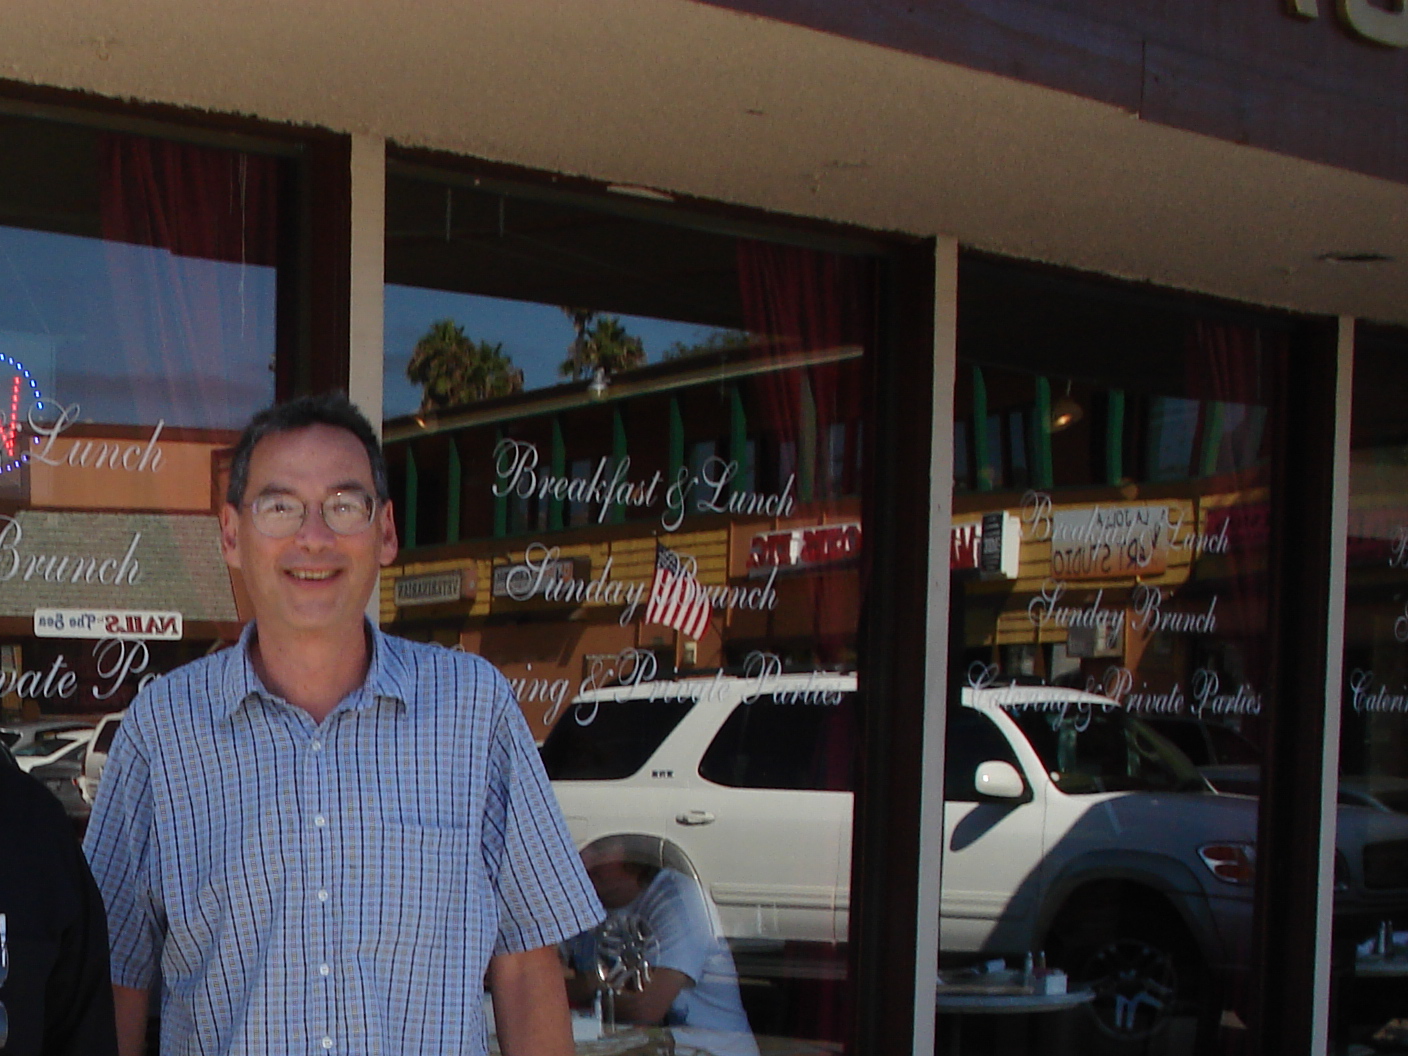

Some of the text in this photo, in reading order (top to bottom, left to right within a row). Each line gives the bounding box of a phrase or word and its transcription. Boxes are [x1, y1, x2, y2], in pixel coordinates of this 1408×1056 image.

[27, 398, 166, 473] Lunch
[492, 438, 795, 532] Breakfast & Lunch
[1020, 490, 1133, 560] Breakfast
[1163, 504, 1229, 554] Lunch
[506, 542, 647, 628] Sunday
[652, 553, 778, 612] Brunch
[1029, 577, 1217, 648] Sunday Brunch
[742, 651, 844, 706] Parties
[1102, 665, 1185, 714] Private
[1191, 669, 1262, 719] Parties
[1350, 667, 1408, 713] Cateri
